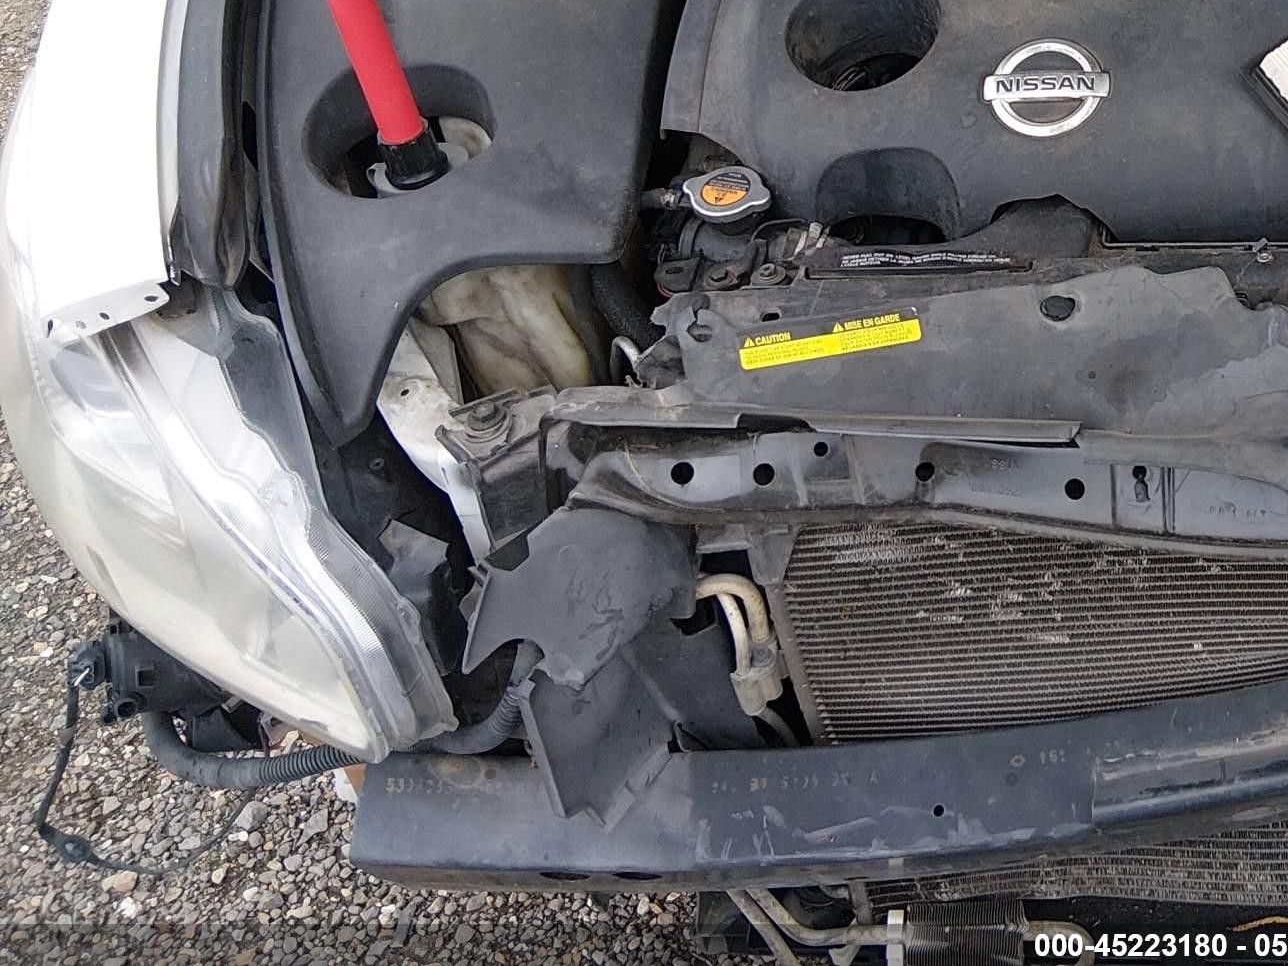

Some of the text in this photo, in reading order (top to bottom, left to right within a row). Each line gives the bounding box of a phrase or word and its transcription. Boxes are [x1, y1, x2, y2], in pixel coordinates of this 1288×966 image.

[996, 77, 1095, 92] NISSAN
[844, 313, 901, 331] MISE EN GARDE
[755, 332, 791, 345] CAUTION
